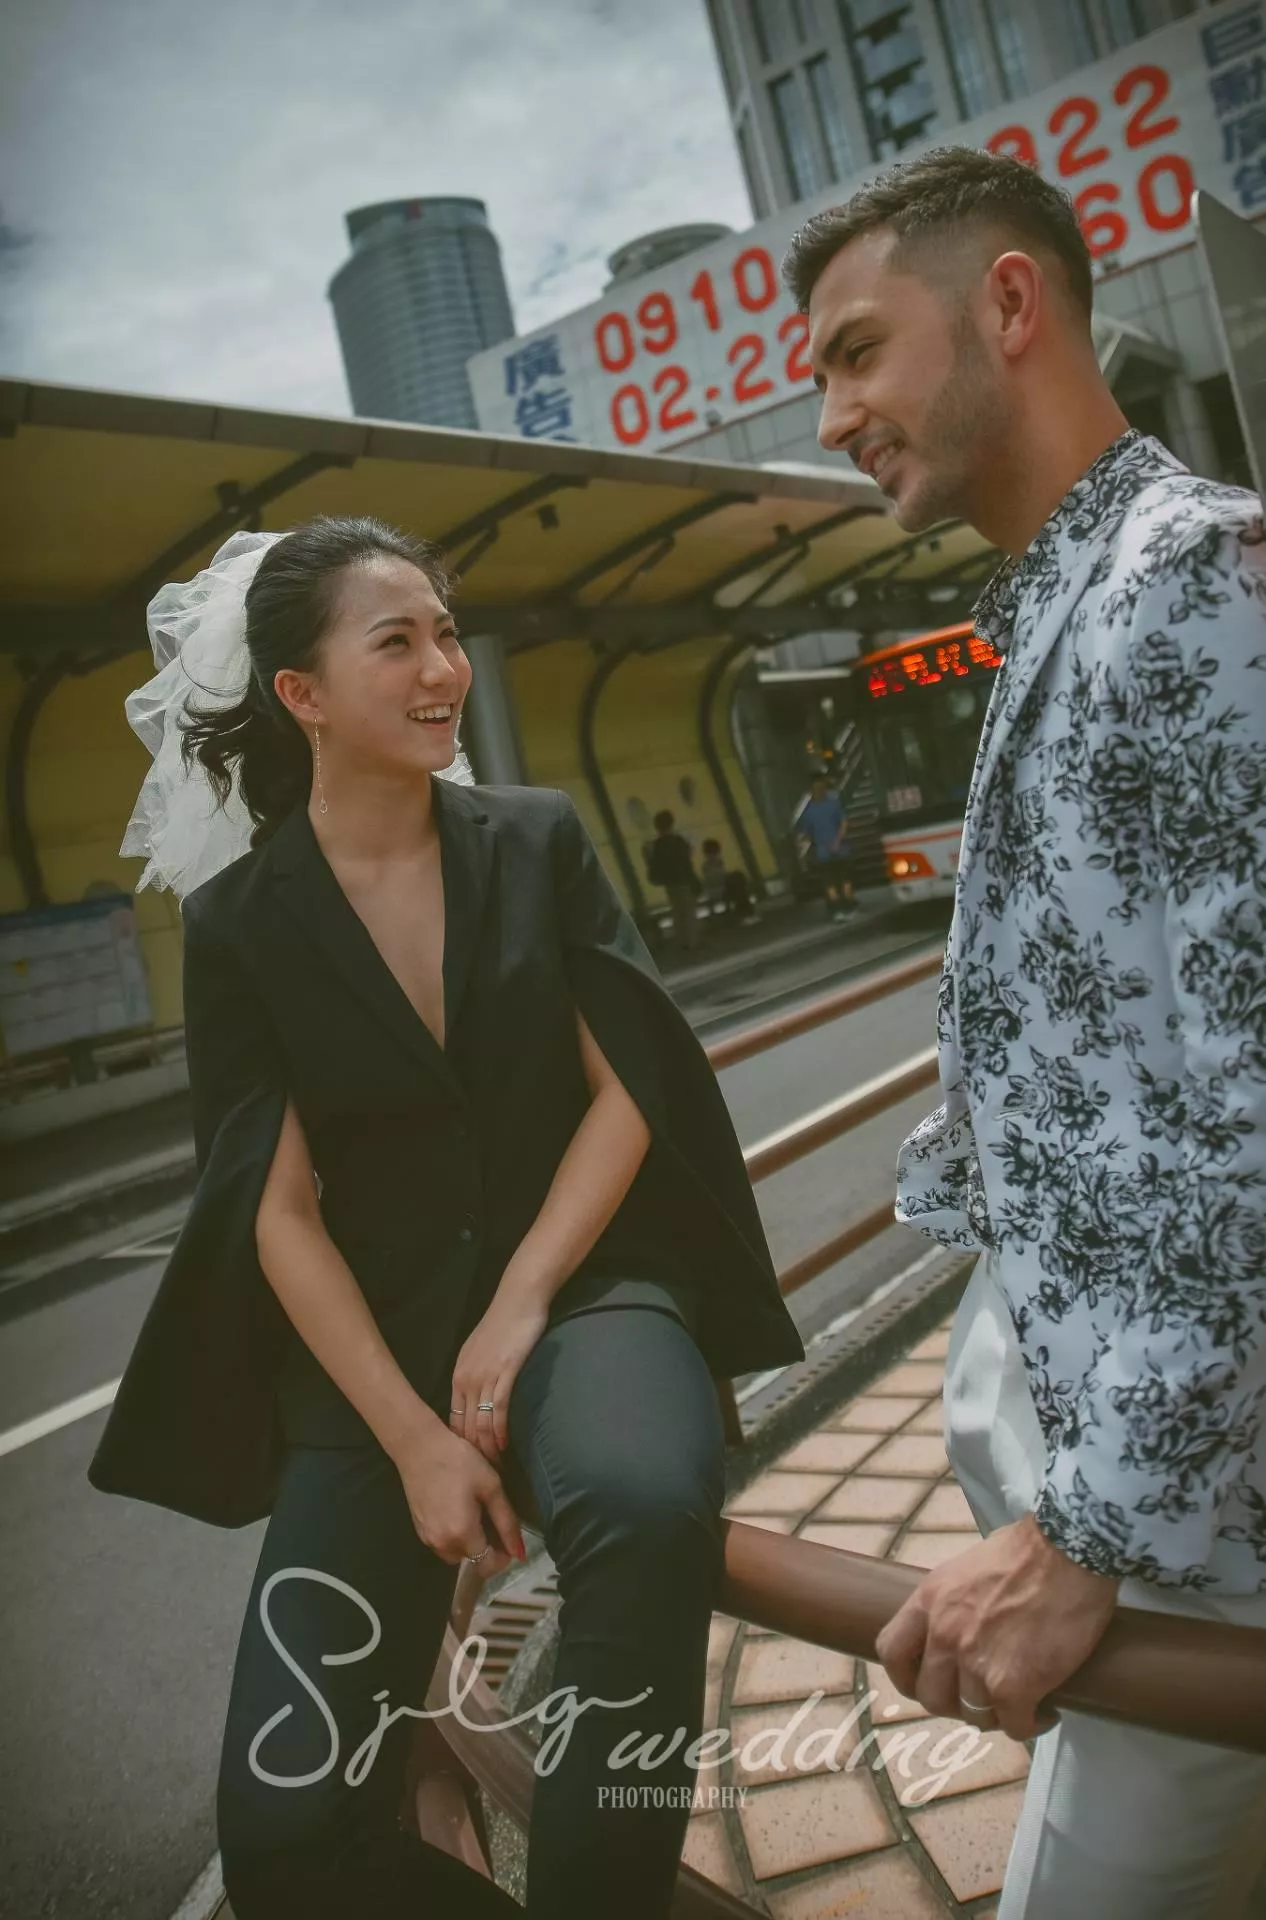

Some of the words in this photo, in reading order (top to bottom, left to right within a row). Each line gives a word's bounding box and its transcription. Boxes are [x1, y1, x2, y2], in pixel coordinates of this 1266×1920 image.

[1074, 154, 1195, 259] 60
[595, 246, 778, 373] 0910
[505, 334, 580, 441] 廣告
